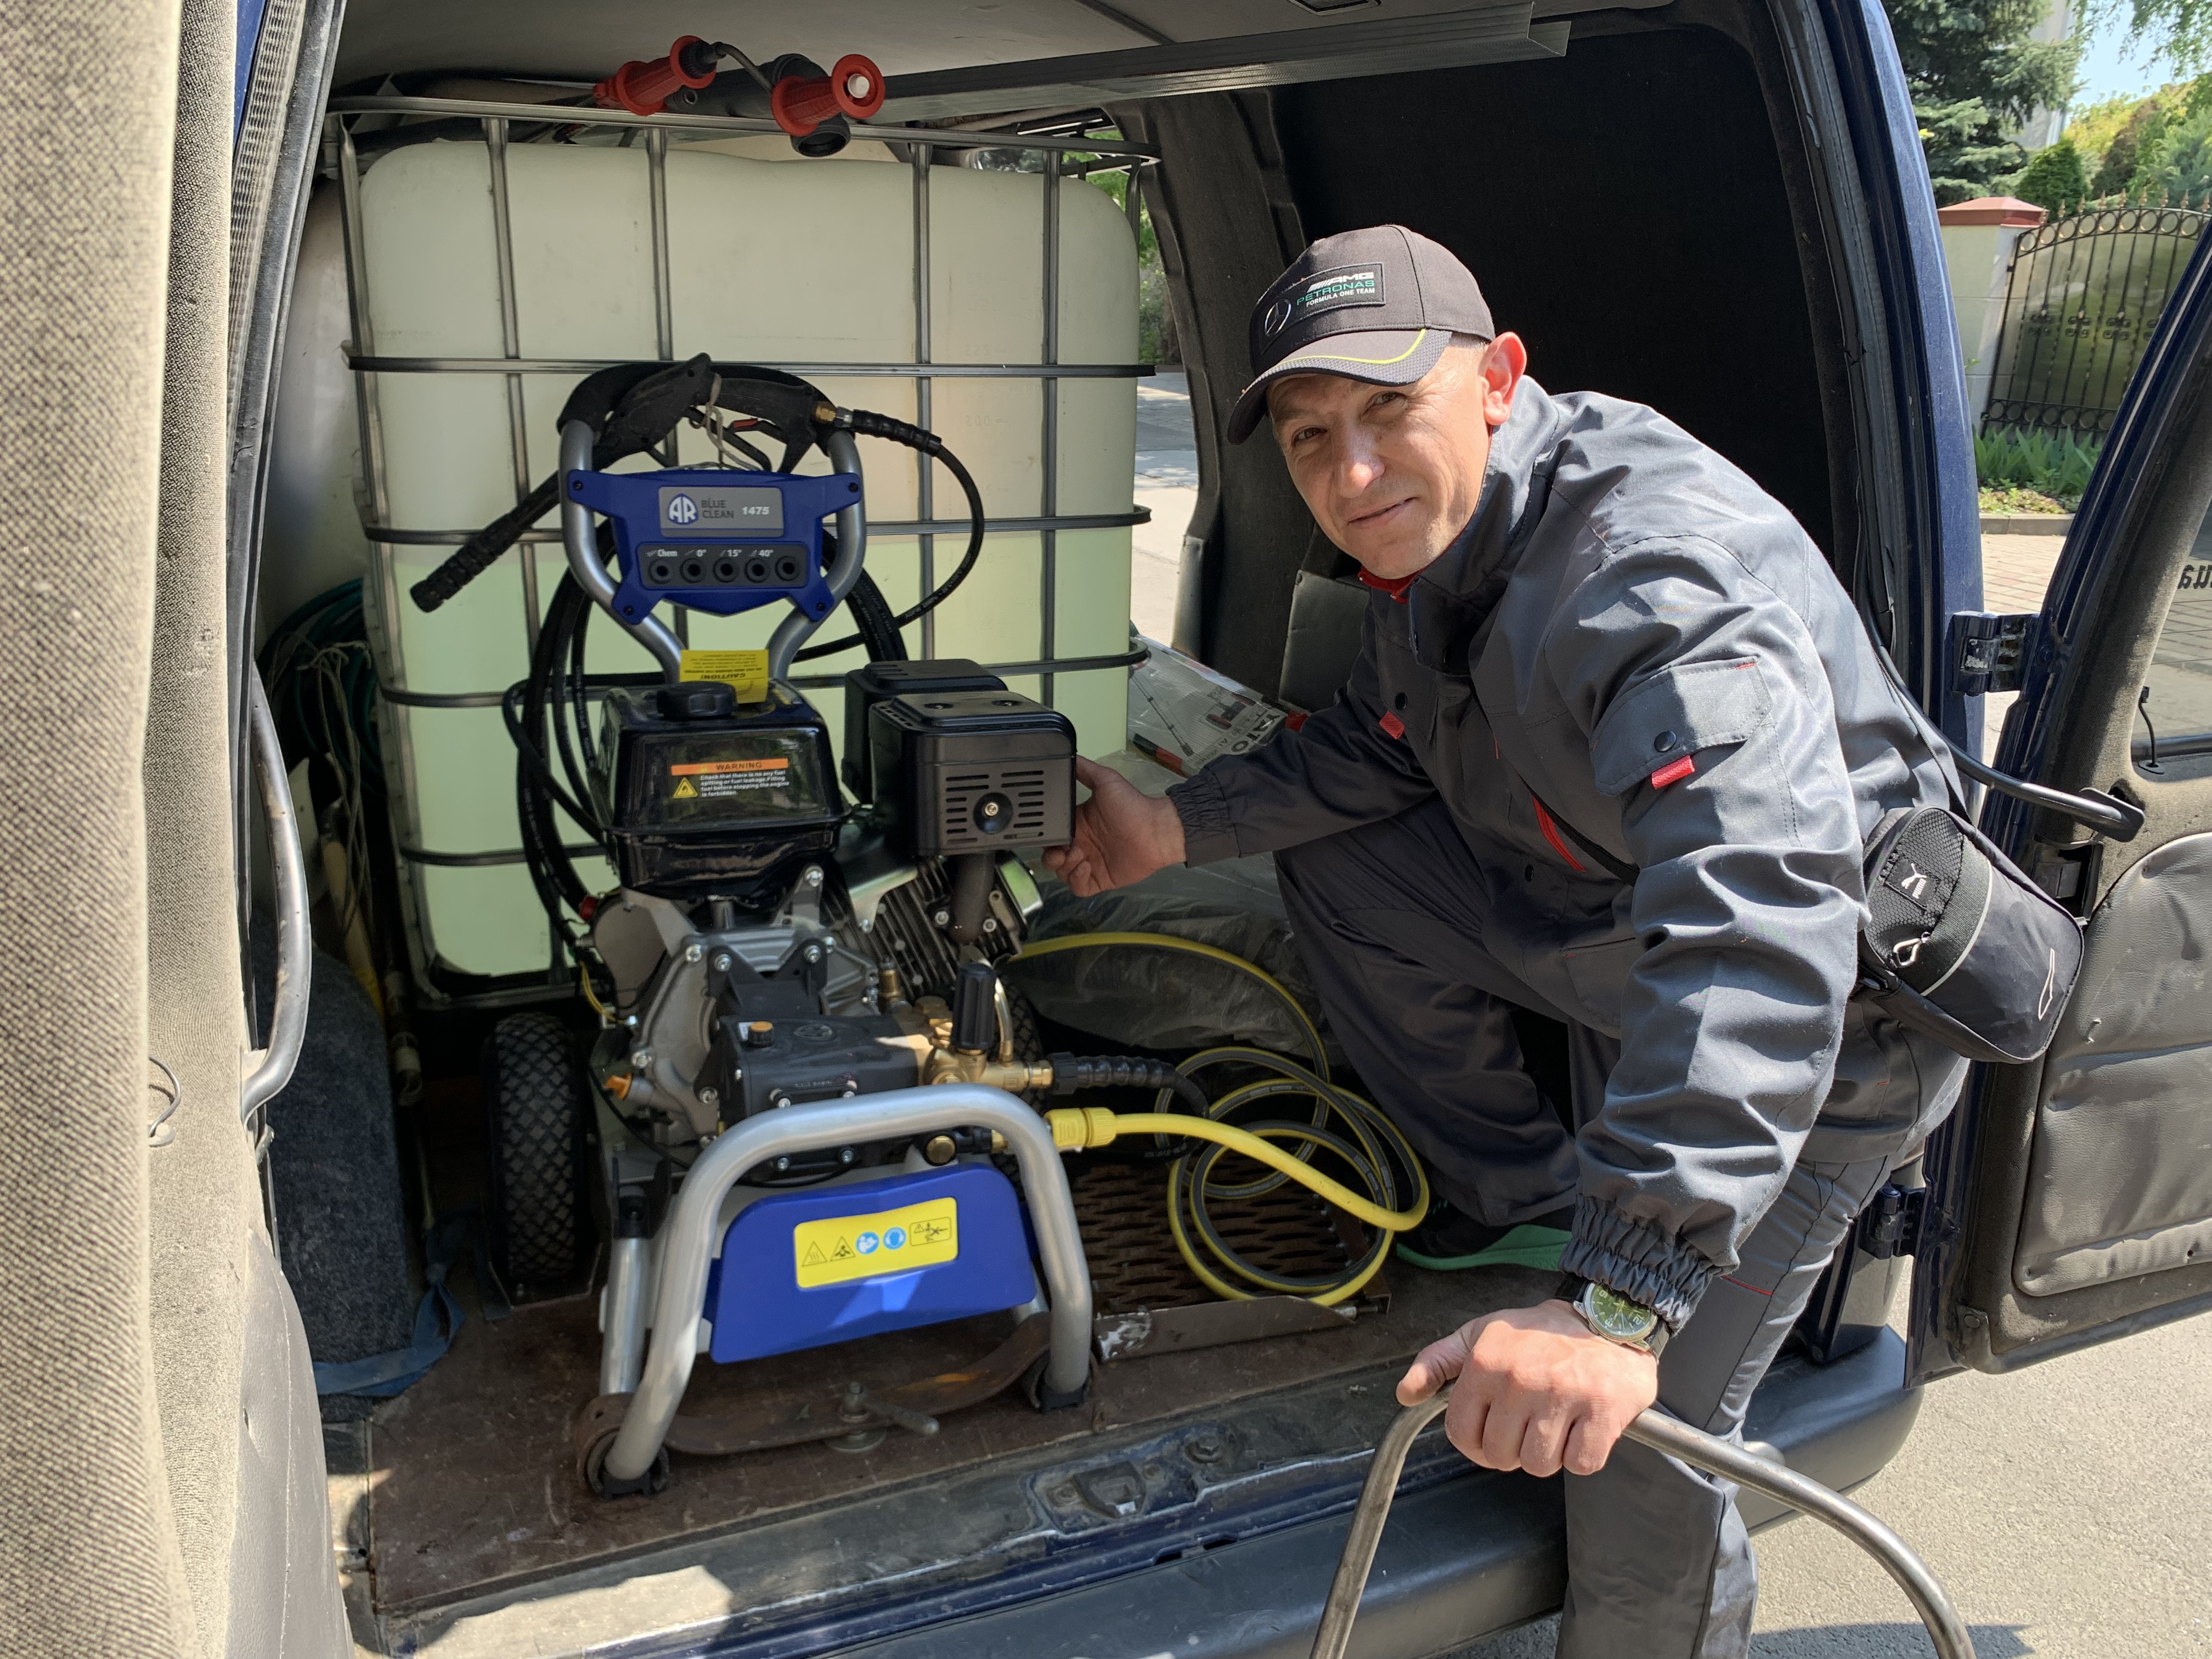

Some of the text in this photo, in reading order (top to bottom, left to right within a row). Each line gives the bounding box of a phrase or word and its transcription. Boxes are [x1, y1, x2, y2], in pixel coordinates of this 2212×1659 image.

[1327, 272, 1374, 286] AMG
[1296, 280, 1375, 306] PETRONAS
[1306, 293, 1338, 308] FORMULA
[701, 499, 726, 508] BLUE
[669, 496, 697, 523] AR
[702, 510, 735, 518] CLEAN
[742, 506, 770, 515] 1475
[657, 549, 678, 557] Chem
[727, 549, 742, 557] 15°
[716, 762, 763, 770] WARNING
[1912, 878, 1927, 899] PUMA
[1604, 1319, 1613, 1327] 3
[1632, 1314, 1645, 1325] 12
